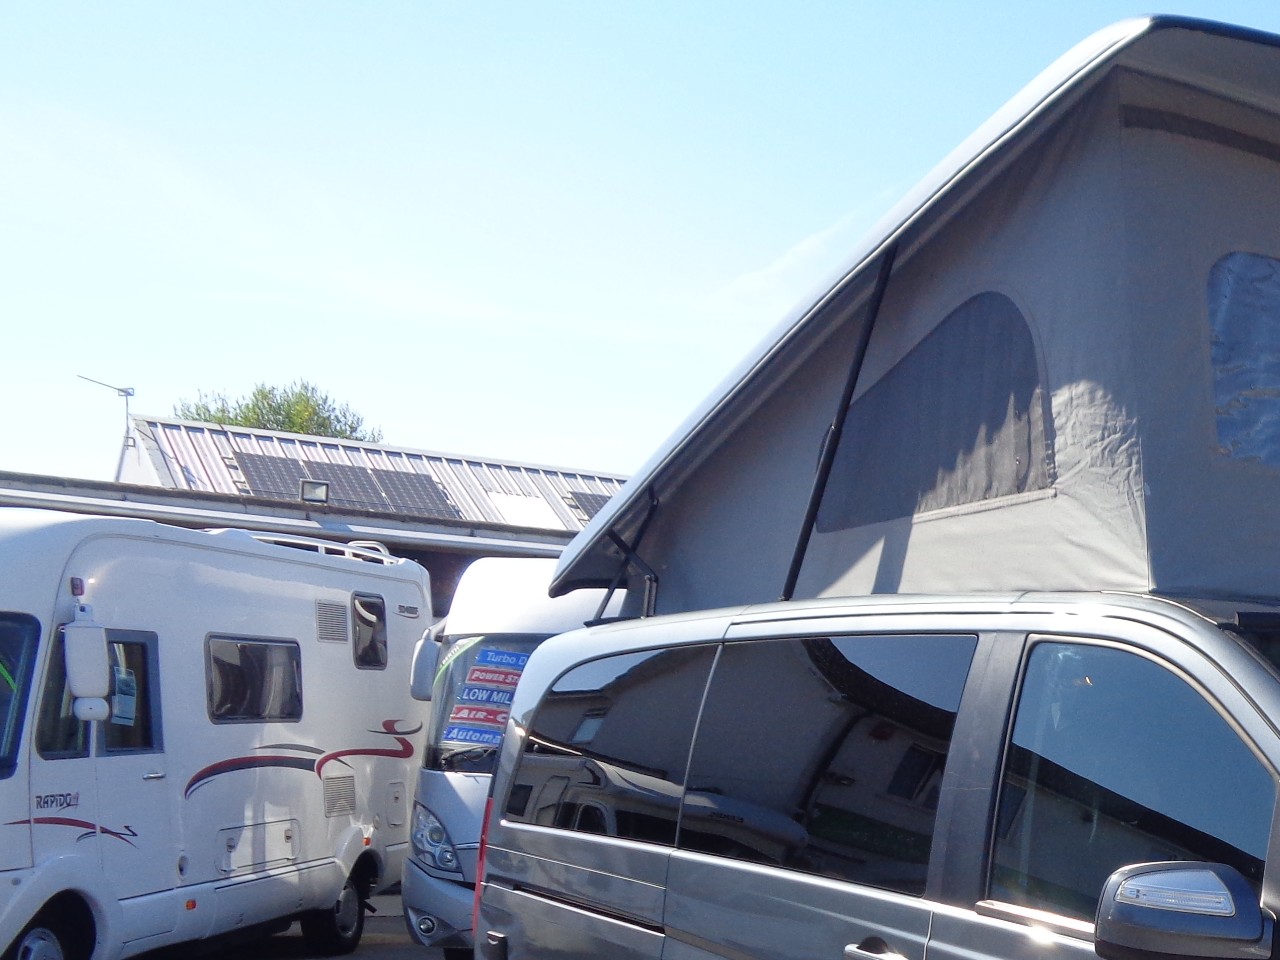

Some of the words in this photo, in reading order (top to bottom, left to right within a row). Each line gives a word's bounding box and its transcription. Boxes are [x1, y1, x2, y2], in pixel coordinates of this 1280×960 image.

[487, 652, 516, 663] Turbo
[471, 671, 504, 682] POWER
[462, 689, 491, 701] LOW
